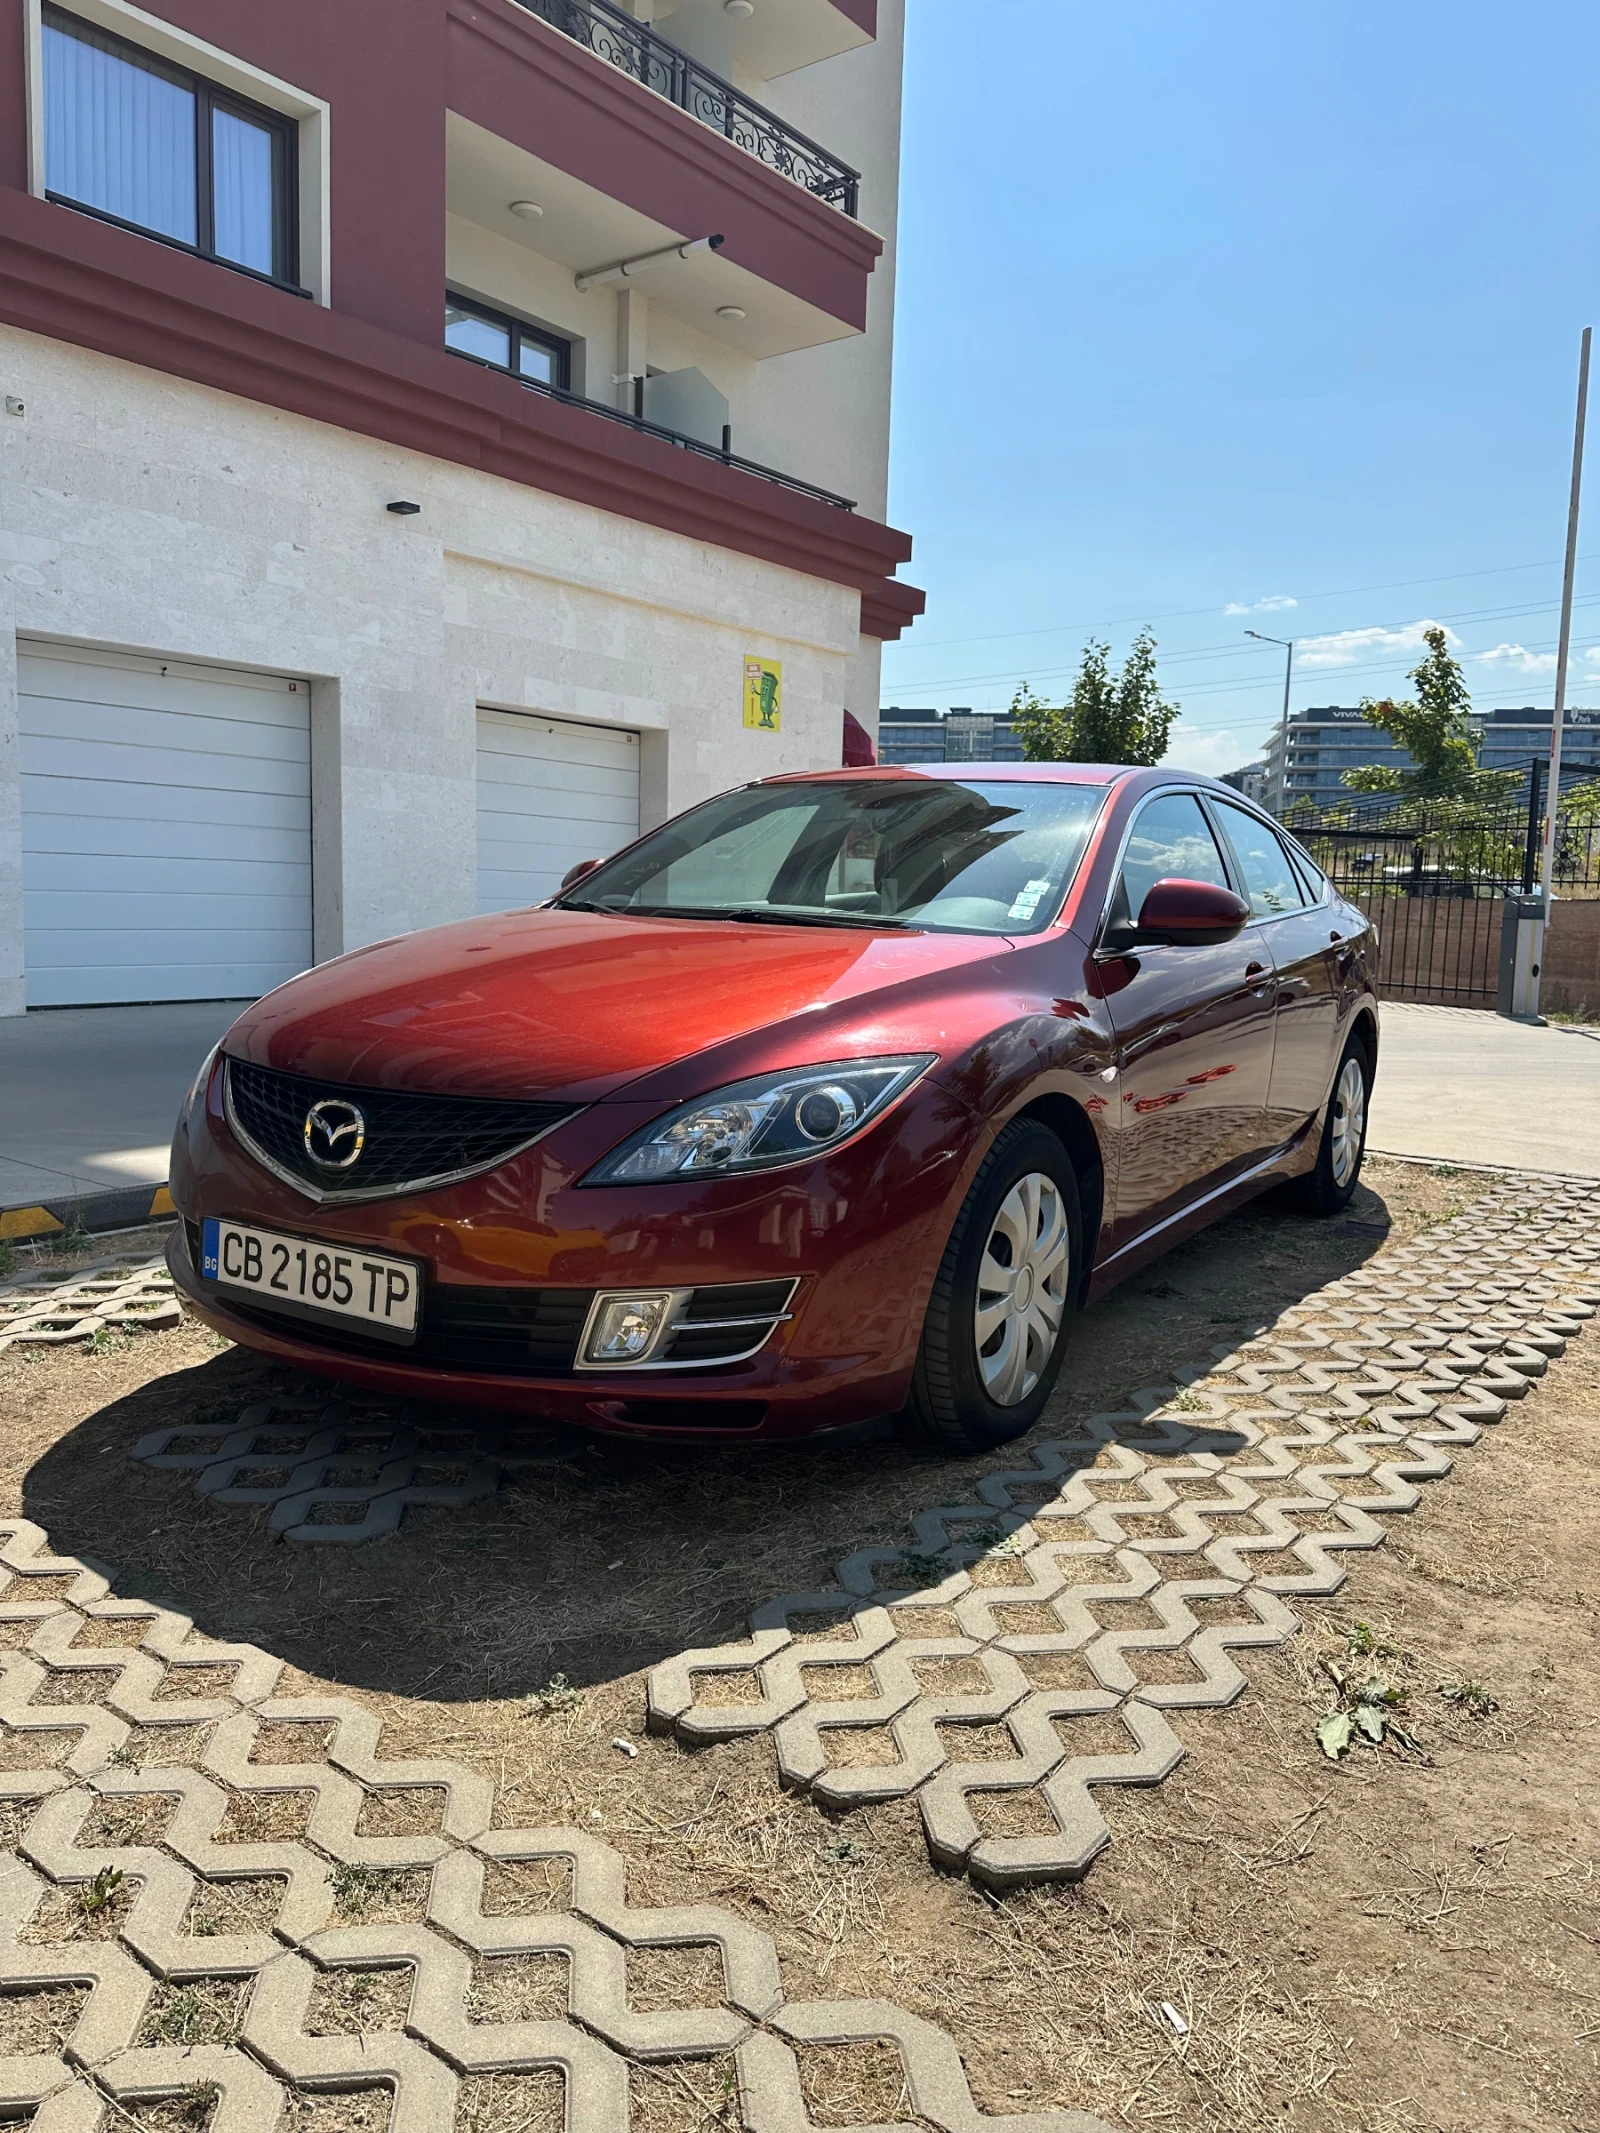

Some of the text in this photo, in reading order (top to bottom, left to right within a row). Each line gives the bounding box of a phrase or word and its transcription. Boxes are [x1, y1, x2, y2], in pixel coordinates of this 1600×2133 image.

[204, 1255, 217, 1271] BG
[223, 1232, 410, 1317] CB 2185 TP
